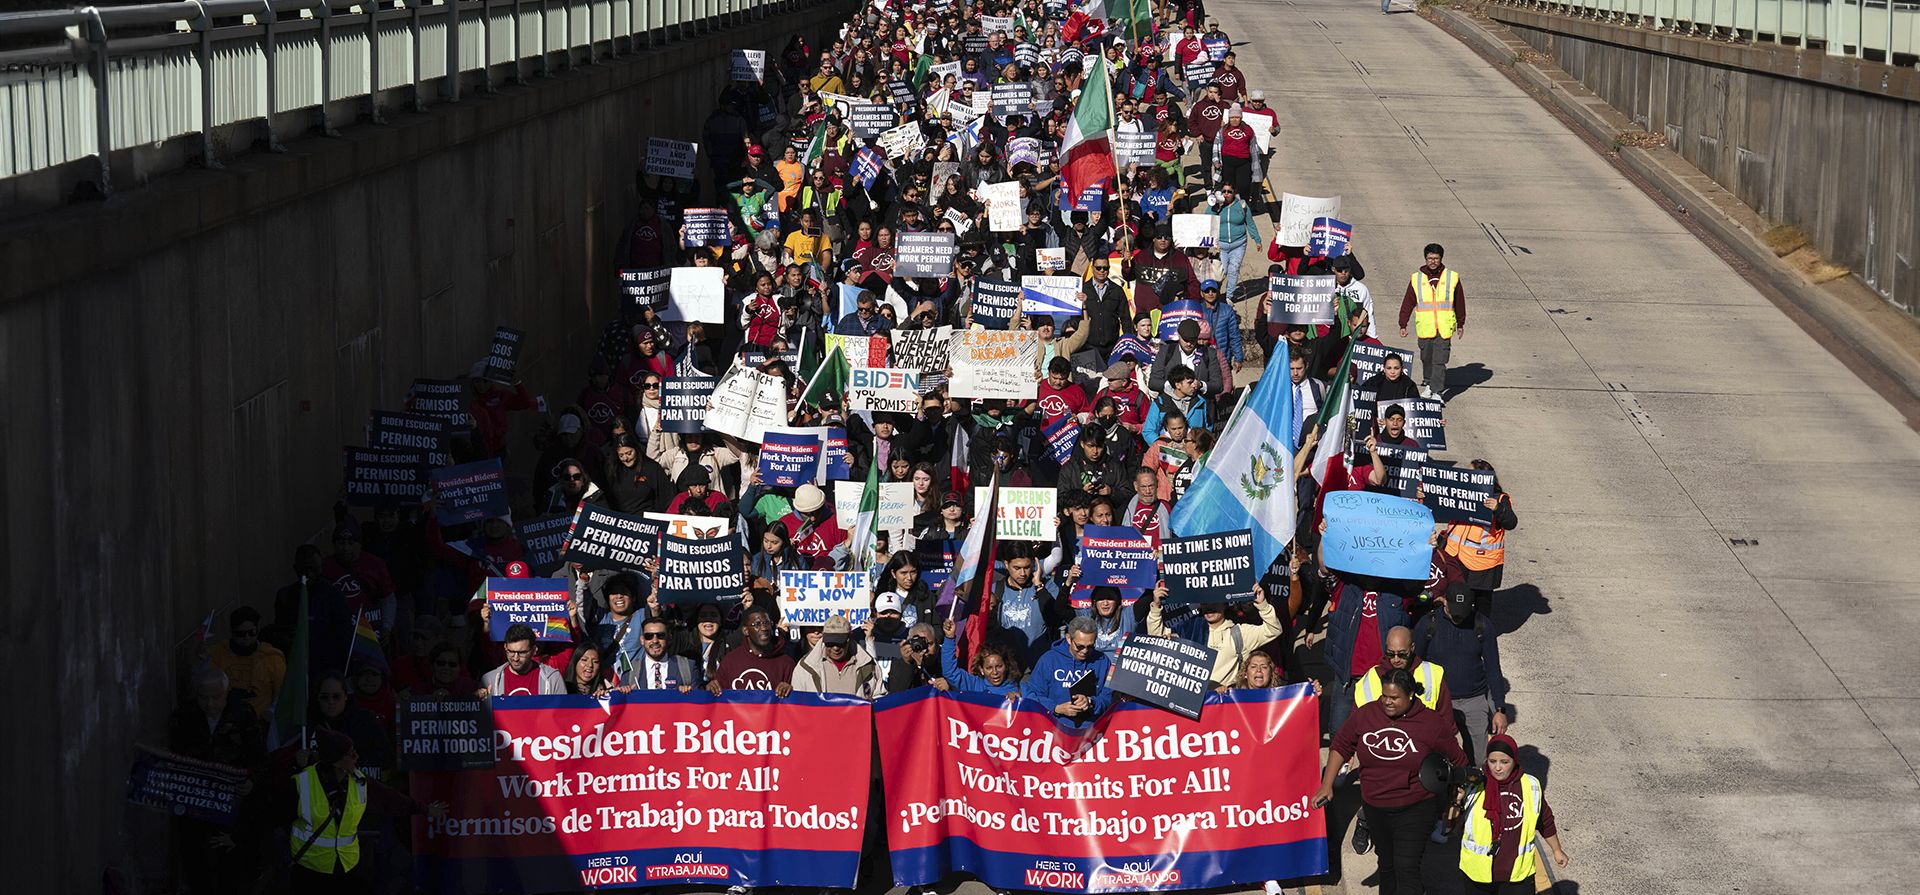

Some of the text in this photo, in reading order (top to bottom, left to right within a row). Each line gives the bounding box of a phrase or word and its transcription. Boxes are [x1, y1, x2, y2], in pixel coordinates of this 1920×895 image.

[670, 141, 690, 151] LLEVO
[647, 155, 684, 168] ESPERANDO
[647, 165, 675, 175] PERMISO
[898, 246, 953, 255] DREAMERS NEED
[899, 255, 951, 264] WORK PERMITS
[623, 269, 659, 281] THE TIME IS
[916, 264, 932, 272] TOO!
[1272, 276, 1335, 288] THE TIME IS NOW!
[1272, 291, 1331, 303] WORK PERMITS
[1285, 303, 1320, 313] FOR ALL!
[900, 329, 938, 344] SOLO
[665, 381, 715, 390] BIDEN ESCUCHA!
[853, 370, 920, 389] BIDEN
[855, 389, 876, 399] you
[865, 397, 918, 412] PROMISED
[1416, 401, 1442, 413] IS NOW!
[661, 409, 684, 421] PARA
[1408, 417, 1441, 428] PERMITS
[1416, 428, 1433, 438] ALL!
[790, 444, 813, 453] Biden:
[354, 451, 420, 464] BIDEN ESCUCHA!
[762, 452, 814, 463] Work Permits
[1405, 450, 1428, 462] NOW!
[354, 467, 416, 481] PERMISOS
[770, 462, 801, 472] For All!
[1421, 466, 1495, 485] THE TIME IS NOW!
[347, 481, 427, 496] PARA TODOS!
[466, 481, 502, 496] Permits
[1421, 482, 1490, 502] WORK PERMITS
[453, 493, 489, 508] For All!
[1007, 490, 1051, 505] DREAMS
[1438, 496, 1477, 512] FOR ALL!
[1015, 506, 1044, 519] NOT
[589, 511, 659, 535] BIDEN ESCUCHA!
[582, 526, 651, 555] PERMISOS
[666, 540, 732, 555] BIDEN ESCUCHA!
[1088, 538, 1127, 548] President
[1163, 533, 1252, 556] THE TIME IS NOW!
[1351, 535, 1405, 550] JUSTICE
[569, 538, 609, 558] PARA
[1086, 548, 1154, 560] Work Permits
[665, 557, 731, 575] PERMISOS
[1100, 559, 1138, 570] For All!
[1164, 556, 1250, 576] WORK PERMITS
[658, 573, 693, 590] PARA
[695, 572, 744, 590] TODOS!
[781, 572, 866, 589] THE TIME
[1106, 577, 1128, 585] WORK
[1185, 573, 1235, 589] FOR ALL!
[494, 591, 562, 600] President Biden:
[786, 588, 856, 602] IS NOW
[492, 602, 565, 613] Work Permits
[509, 613, 548, 623] For All!
[1133, 635, 1208, 661] PRESIDENT BIDEN:
[1122, 646, 1210, 682] DREAMERS NEED
[1121, 657, 1203, 695] WORK PERMITS
[731, 677, 773, 690] CASA
[1146, 679, 1171, 699] TOO!
[410, 701, 481, 713] BIDEN ESCUCHA!
[411, 719, 478, 736] PERMISOS
[403, 737, 492, 754] PARA TODOS!
[493, 720, 793, 763] President Biden:
[1114, 724, 1242, 762] Biden:
[498, 765, 781, 800] Work Permits For All!
[956, 761, 1231, 801] Work Permits For All!
[427, 801, 860, 840] ¡Permisos de Trabajo para Todos!
[1010, 807, 1041, 834] de
[1043, 807, 1142, 844] Trabajo
[1153, 805, 1218, 840] para
[1220, 795, 1311, 830] Todos!
[587, 857, 629, 868] HERE TO
[674, 851, 703, 864] AQUÍ
[646, 865, 729, 879] YTRABAJANDO
[1035, 860, 1076, 871] HERE TO
[1122, 859, 1152, 874] AQUÍ
[581, 867, 638, 885] WORK
[1025, 870, 1085, 890] WORK
[1094, 869, 1180, 886] YTRABAJANDO
